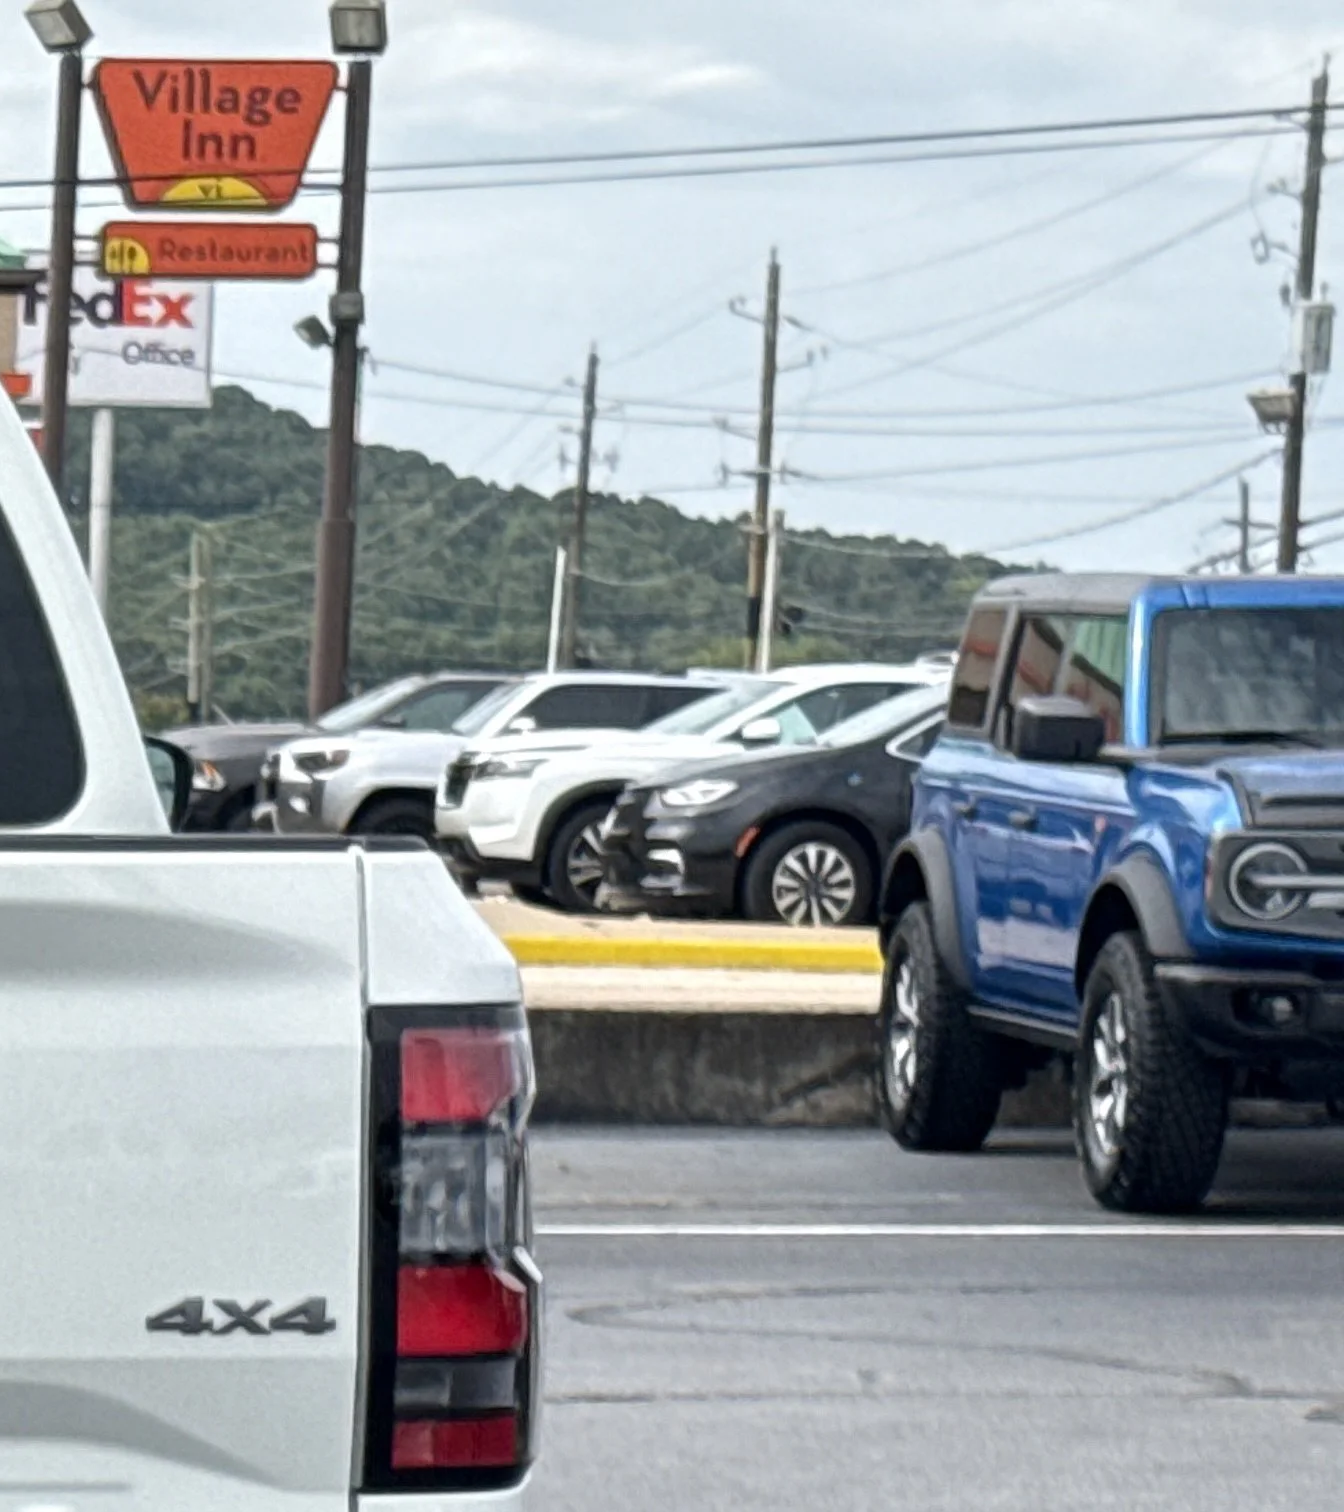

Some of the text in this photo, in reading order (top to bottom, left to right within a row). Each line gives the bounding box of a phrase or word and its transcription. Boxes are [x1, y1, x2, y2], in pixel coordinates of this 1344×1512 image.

[132, 67, 301, 126] Village
[181, 120, 257, 161] Inn
[160, 238, 310, 263] Restaurant
[122, 341, 195, 366] Office
